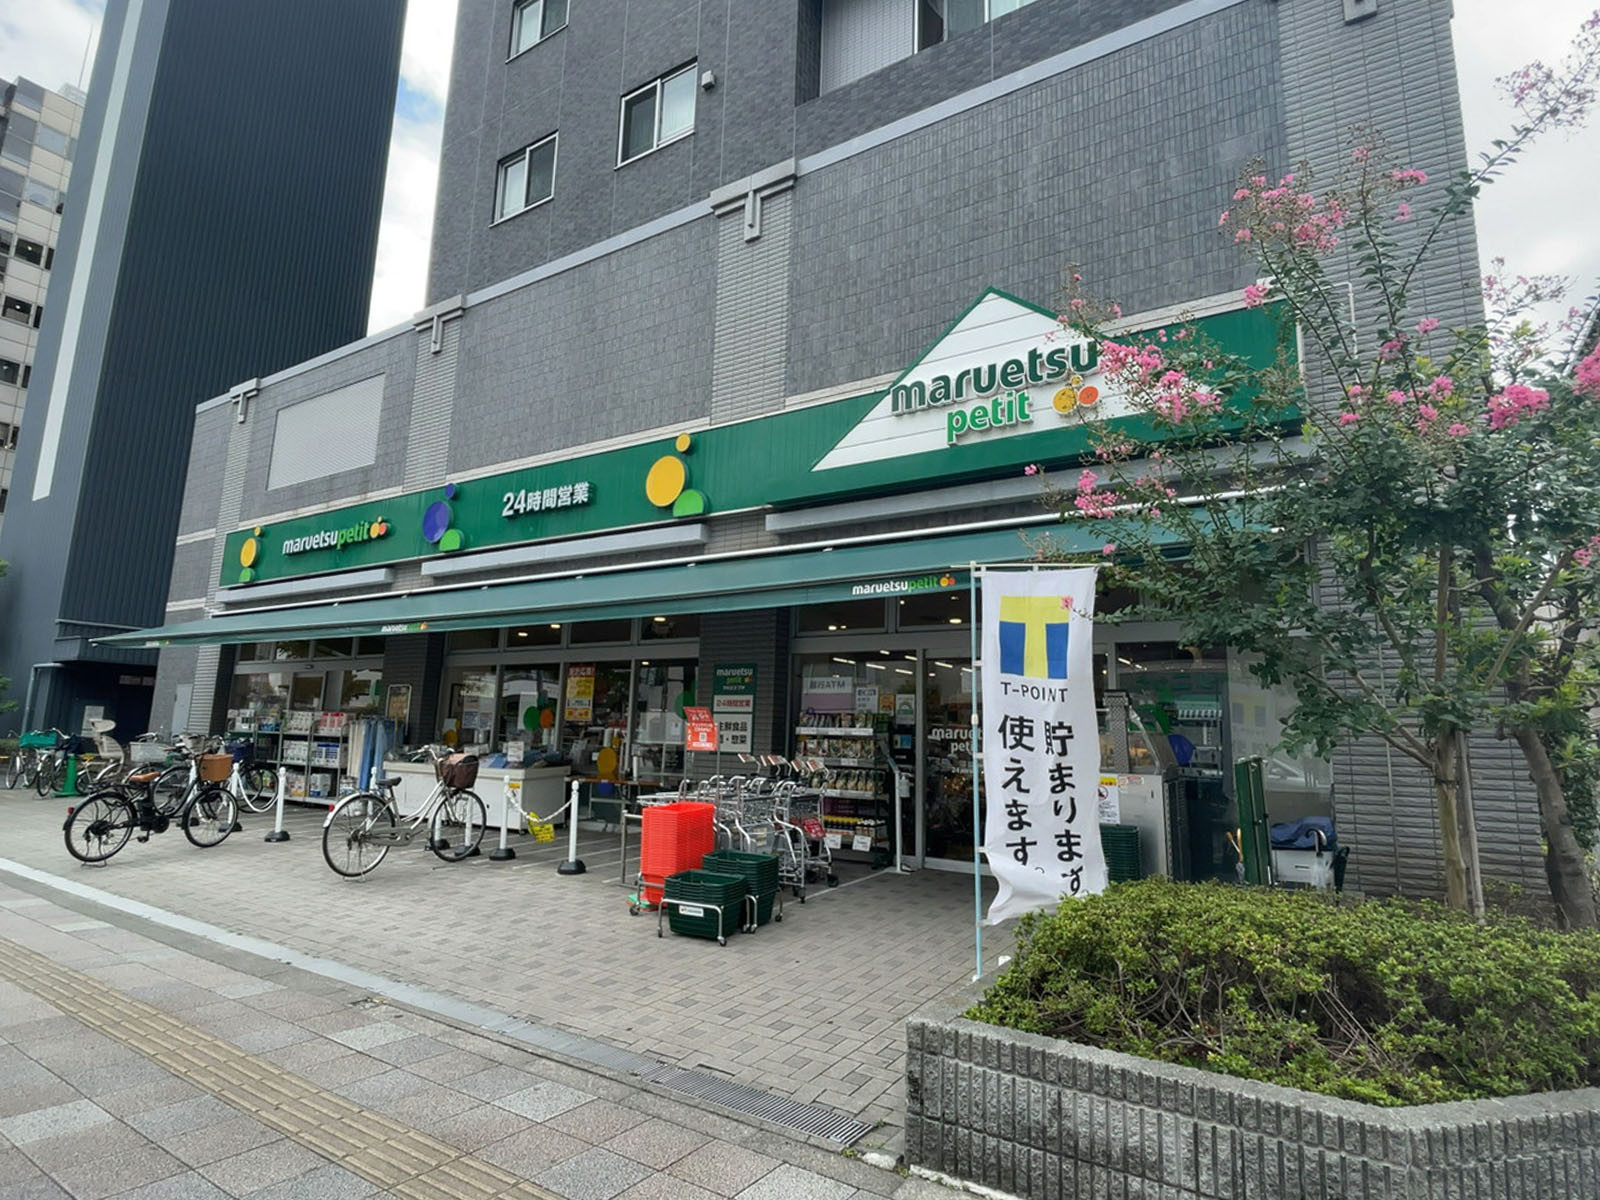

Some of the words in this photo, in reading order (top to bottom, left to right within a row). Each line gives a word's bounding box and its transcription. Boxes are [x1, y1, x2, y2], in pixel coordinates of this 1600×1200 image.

[891, 340, 1100, 415] maruetsu
[946, 391, 1033, 444] petit
[502, 481, 590, 517] 24時間営業
[1000, 681, 1069, 703] T-POINT
